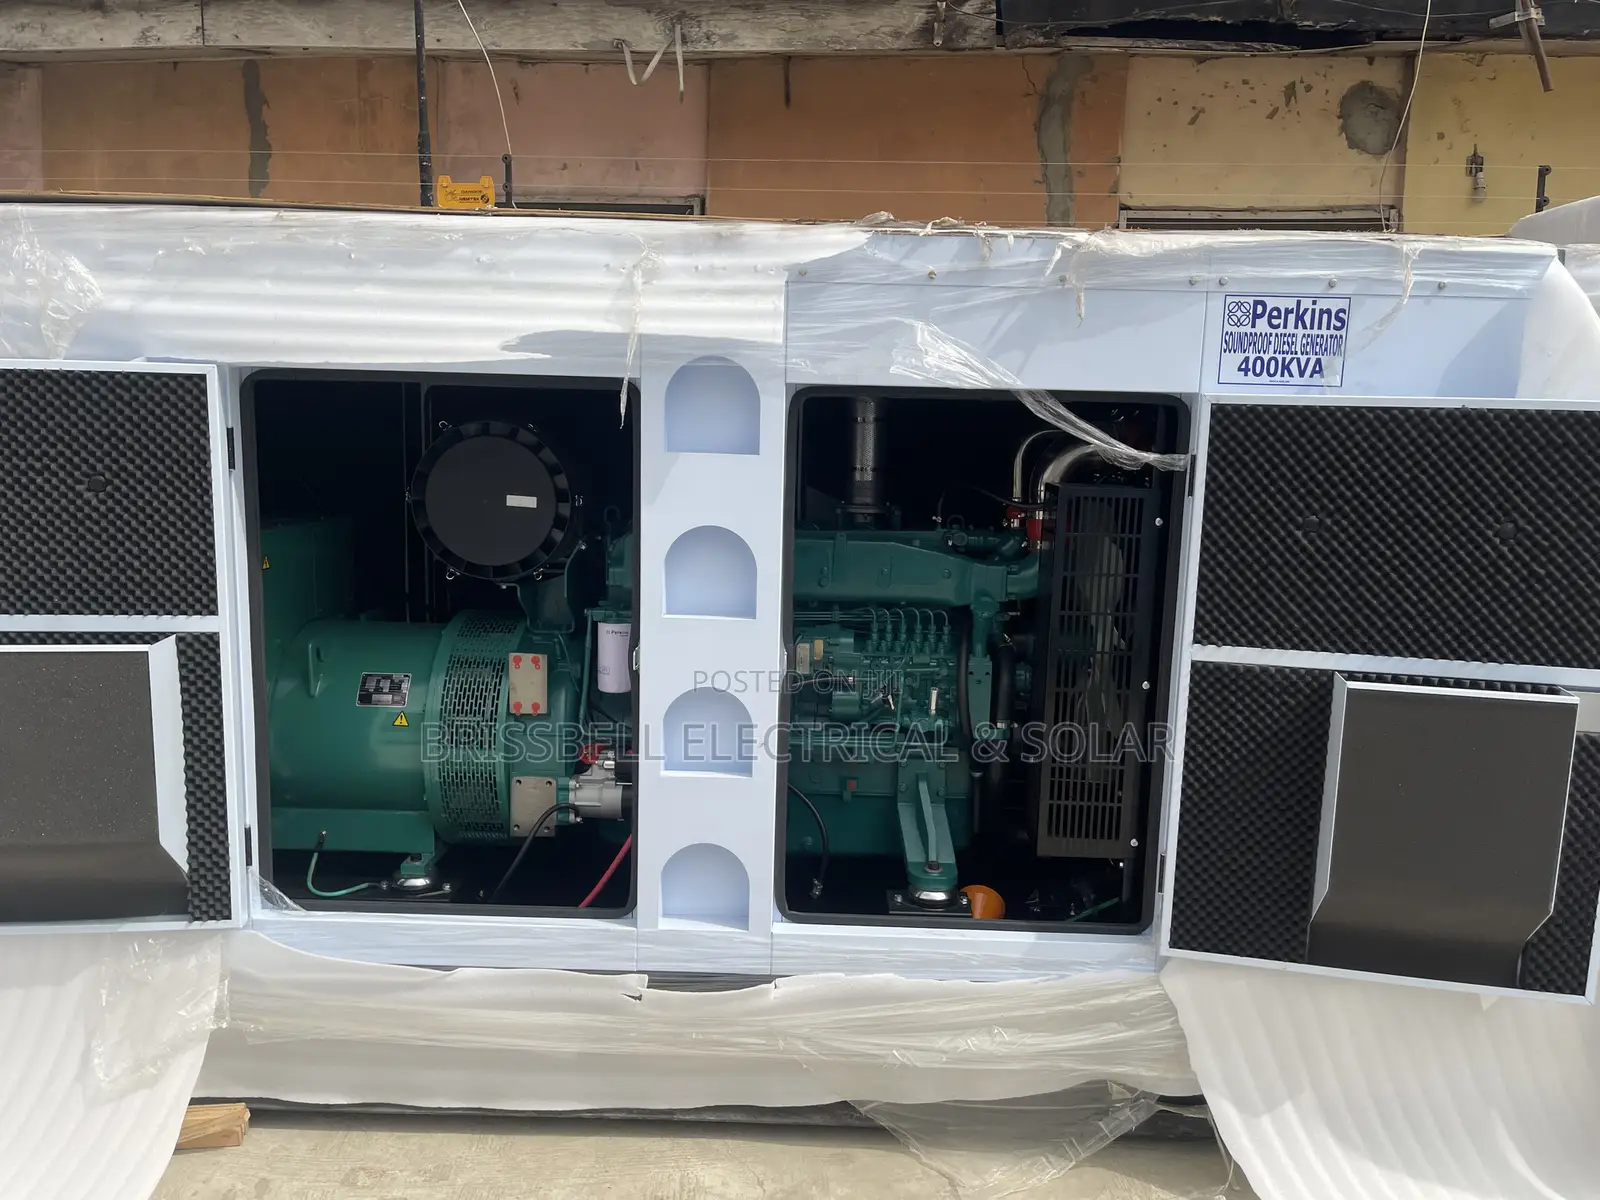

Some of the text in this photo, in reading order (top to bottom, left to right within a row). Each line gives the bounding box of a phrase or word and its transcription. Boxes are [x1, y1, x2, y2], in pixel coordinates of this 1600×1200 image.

[1250, 299, 1347, 331] Perkins
[1223, 331, 1344, 357] SOUNDPROOF DIESEL GENERATOR
[1237, 356, 1324, 379] 400KVA
